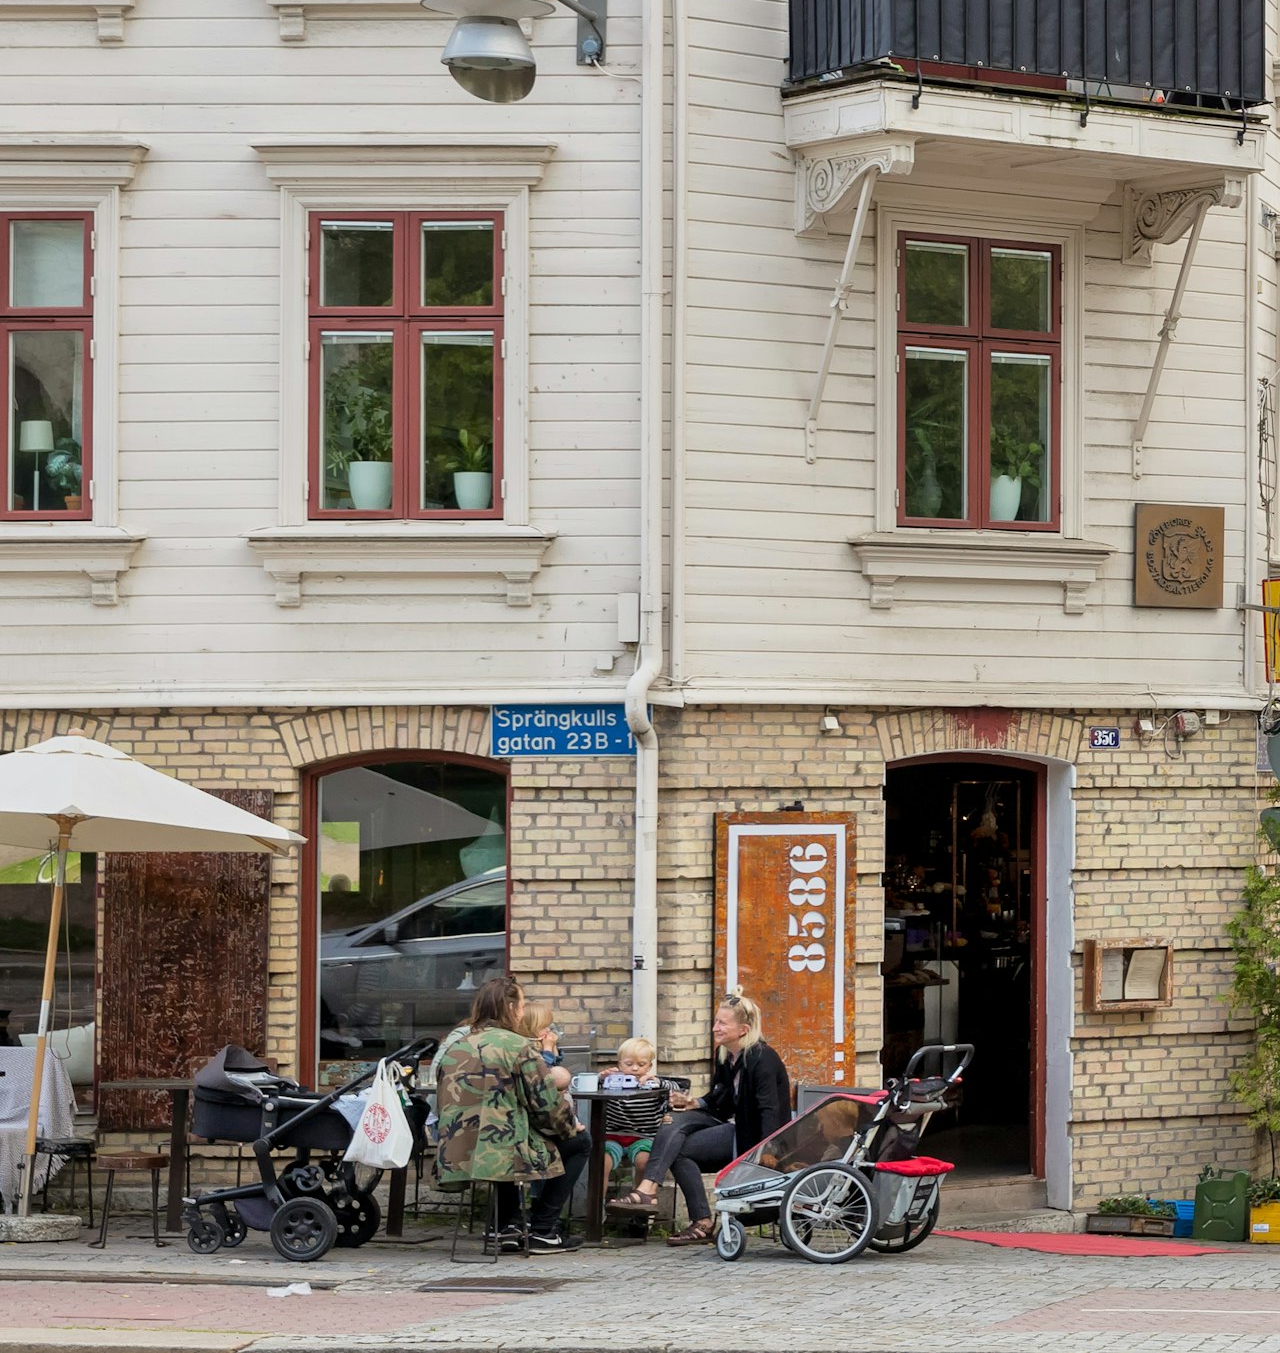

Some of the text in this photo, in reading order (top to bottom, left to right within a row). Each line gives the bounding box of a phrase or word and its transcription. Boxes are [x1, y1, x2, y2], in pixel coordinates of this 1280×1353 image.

[498, 710, 617, 731] Sprängkulls
[498, 734, 556, 754] gatan
[1094, 730, 1116, 746] 35C
[788, 843, 827, 972] 8586
